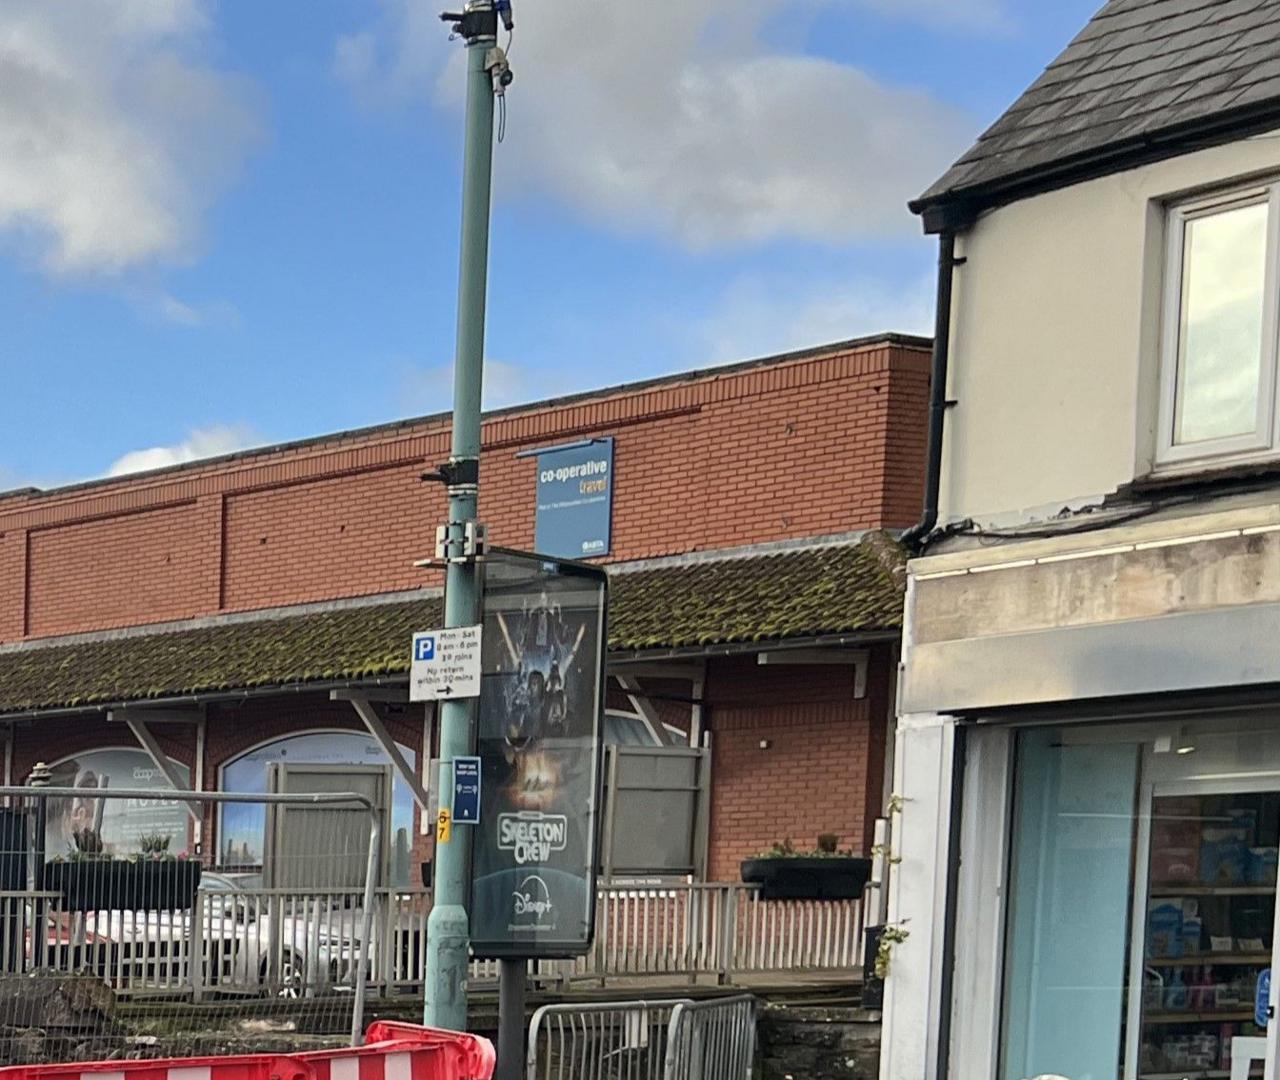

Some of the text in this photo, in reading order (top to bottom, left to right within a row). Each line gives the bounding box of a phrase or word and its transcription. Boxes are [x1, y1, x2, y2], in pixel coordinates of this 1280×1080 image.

[540, 460, 608, 483] co-operative
[580, 475, 608, 494] travel
[501, 819, 564, 843] SKELETON
[514, 841, 552, 865] CREW
